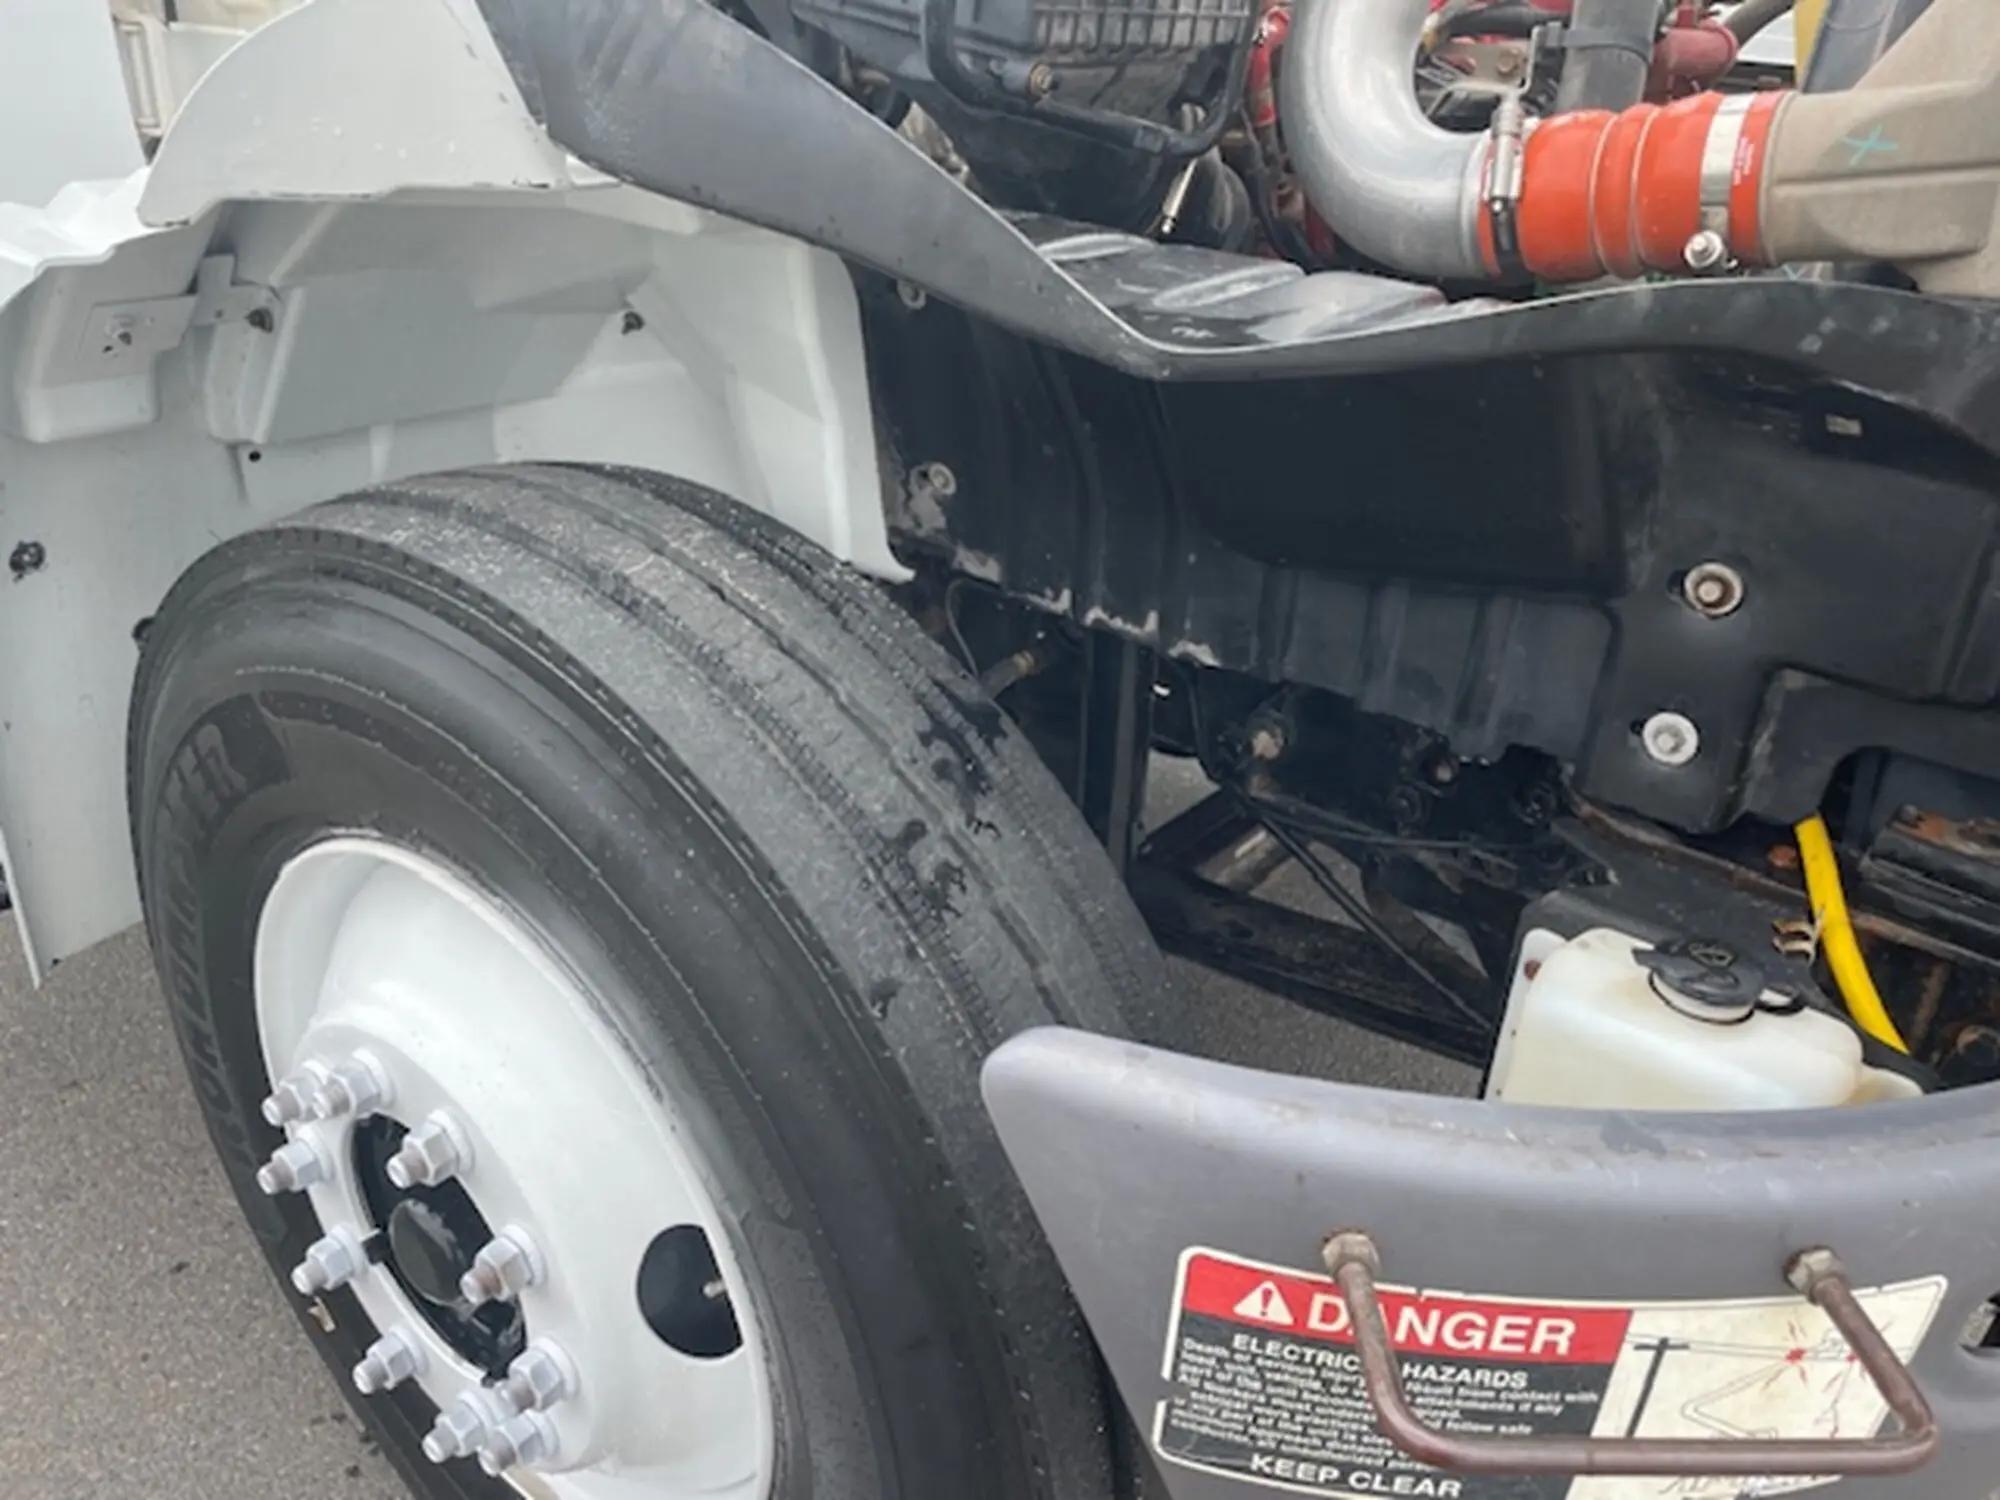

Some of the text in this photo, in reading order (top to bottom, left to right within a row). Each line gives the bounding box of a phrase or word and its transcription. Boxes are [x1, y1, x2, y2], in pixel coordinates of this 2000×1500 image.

[1307, 1291, 1576, 1356] DNGER
[1182, 1337, 1231, 1358] Death
[1232, 1351, 1251, 1363] or
[1256, 1357, 1316, 1376] serious
[1457, 1384, 1495, 1398] from
[1499, 1385, 1560, 1404] contact
[1564, 1389, 1598, 1403] with
[1232, 1333, 1529, 1389] ELECTRIC HAZARDS
[1235, 1374, 1263, 1391] the
[1414, 1392, 1514, 1414] attachments
[1534, 1401, 1564, 1416] any
[1250, 1453, 1463, 1498] KEEP CLEAR
